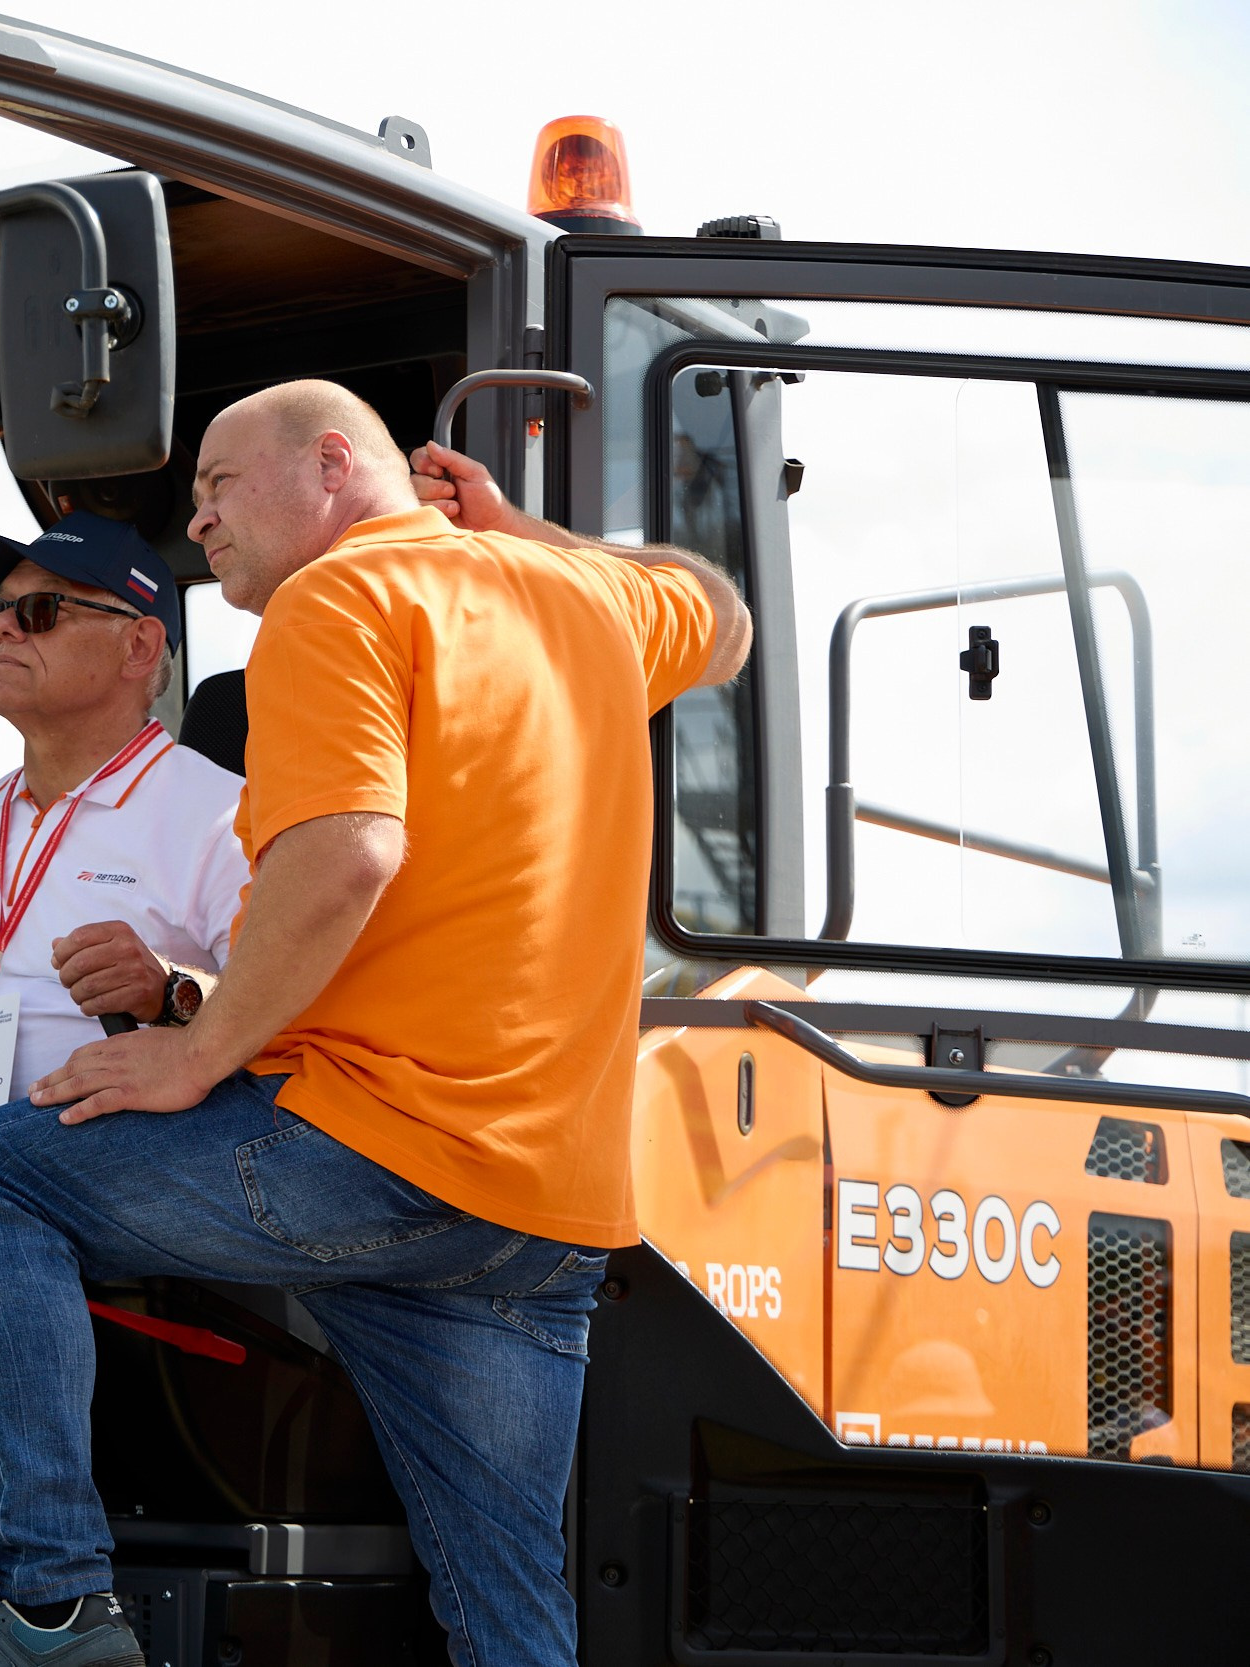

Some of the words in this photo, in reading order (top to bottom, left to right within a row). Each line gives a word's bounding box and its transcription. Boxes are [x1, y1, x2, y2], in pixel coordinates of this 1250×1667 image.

[94, 873, 137, 884] АВТОДОР
[838, 1178, 1061, 1288] E330C
[705, 1262, 782, 1319] ROPS
